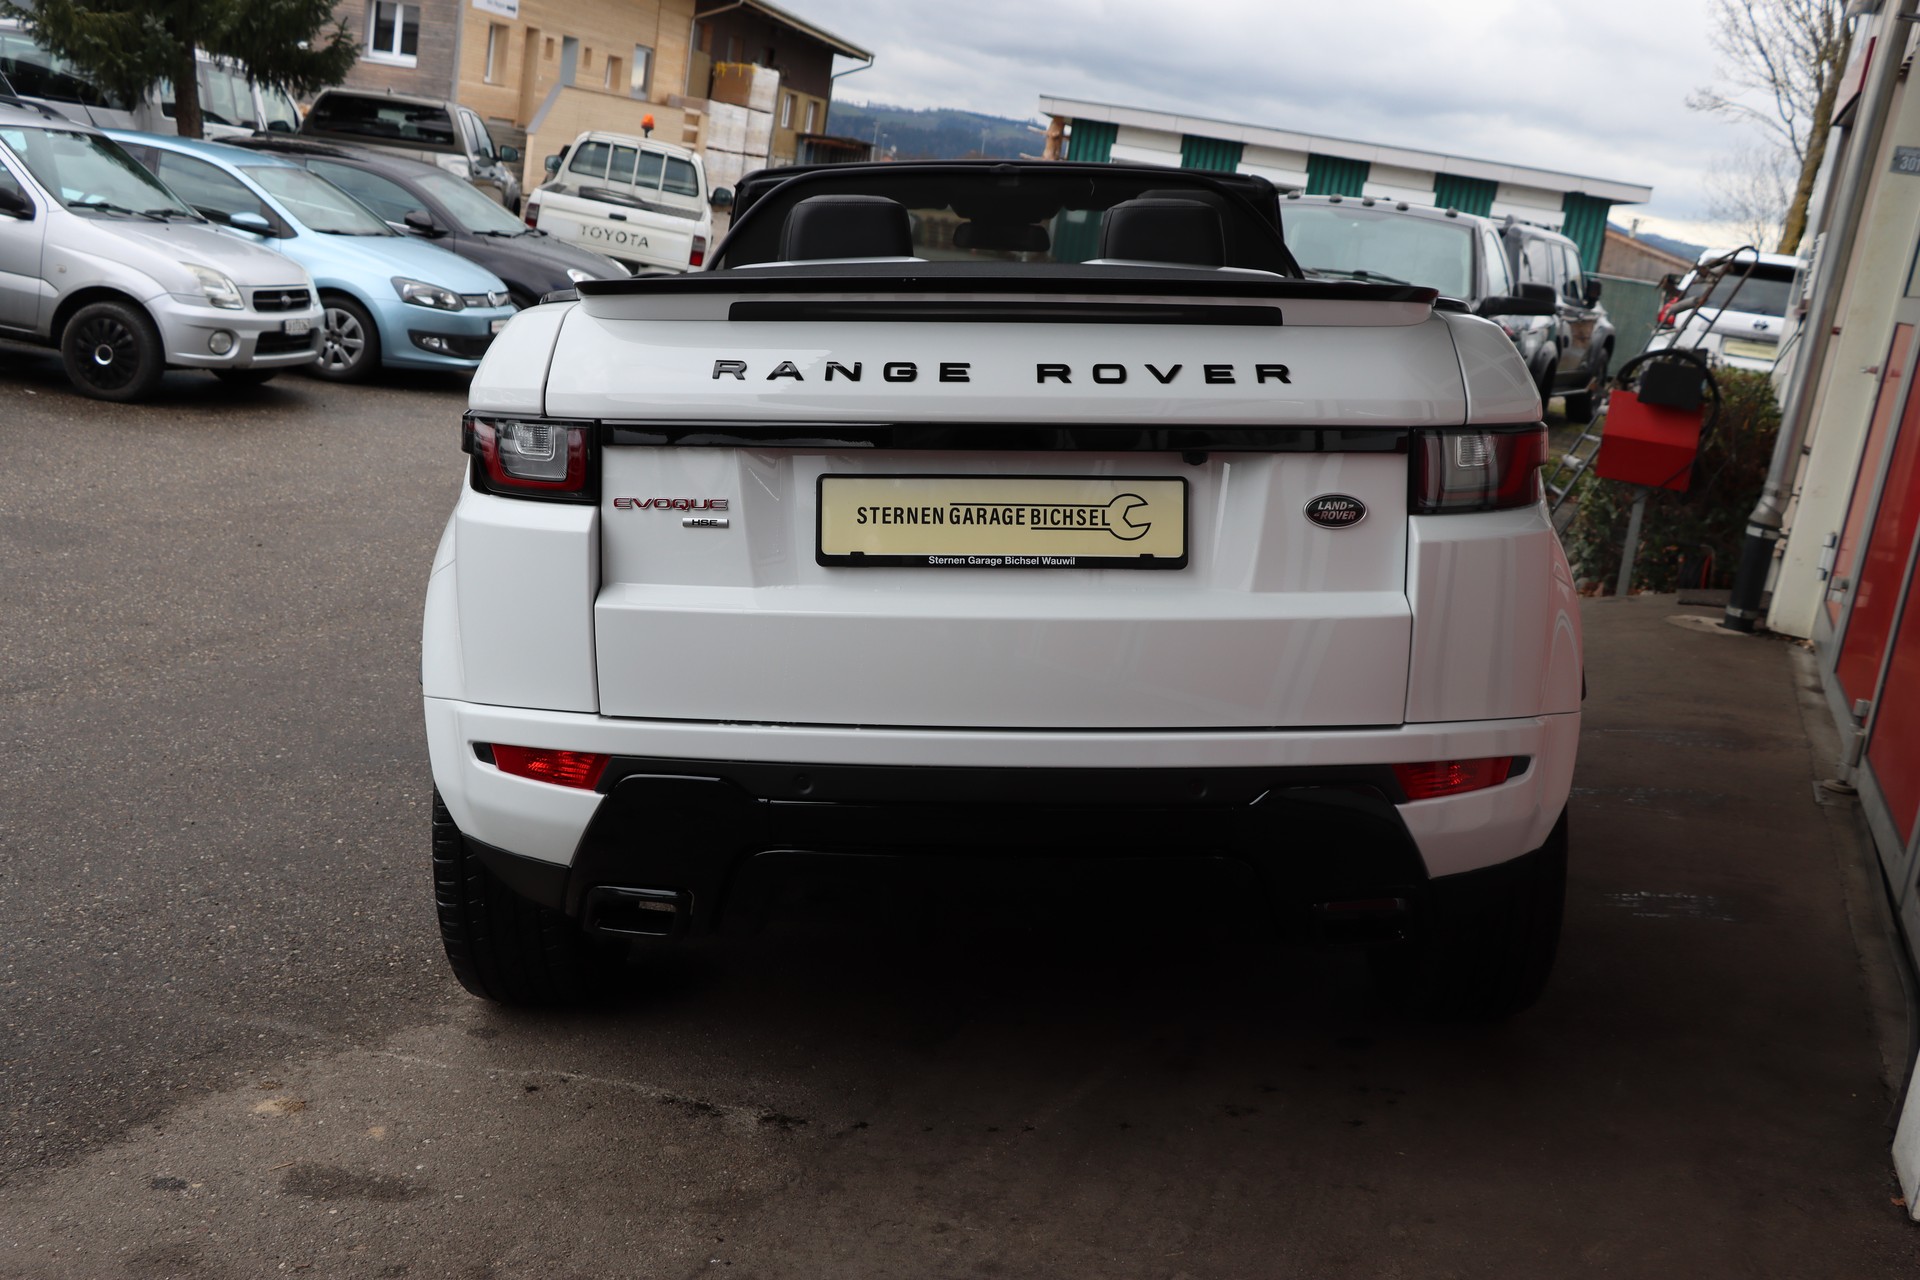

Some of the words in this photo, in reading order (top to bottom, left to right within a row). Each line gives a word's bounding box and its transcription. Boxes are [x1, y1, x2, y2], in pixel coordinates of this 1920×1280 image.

[581, 224, 649, 248] TOYOTA
[712, 359, 972, 382] RANGE
[1036, 363, 1292, 384] ROVER
[613, 497, 729, 512] EVOQUE
[1318, 501, 1348, 510] LAND
[856, 506, 945, 525] STERNEN
[949, 507, 1026, 526] GARAGE
[1030, 508, 1111, 527] BICHSEL
[1320, 510, 1357, 520] ROVER
[691, 519, 718, 527] HSE
[928, 556, 966, 565] Sternen
[968, 556, 1002, 567] Garage
[1005, 556, 1040, 565] Bichsel
[1042, 556, 1076, 565] Wauwil
